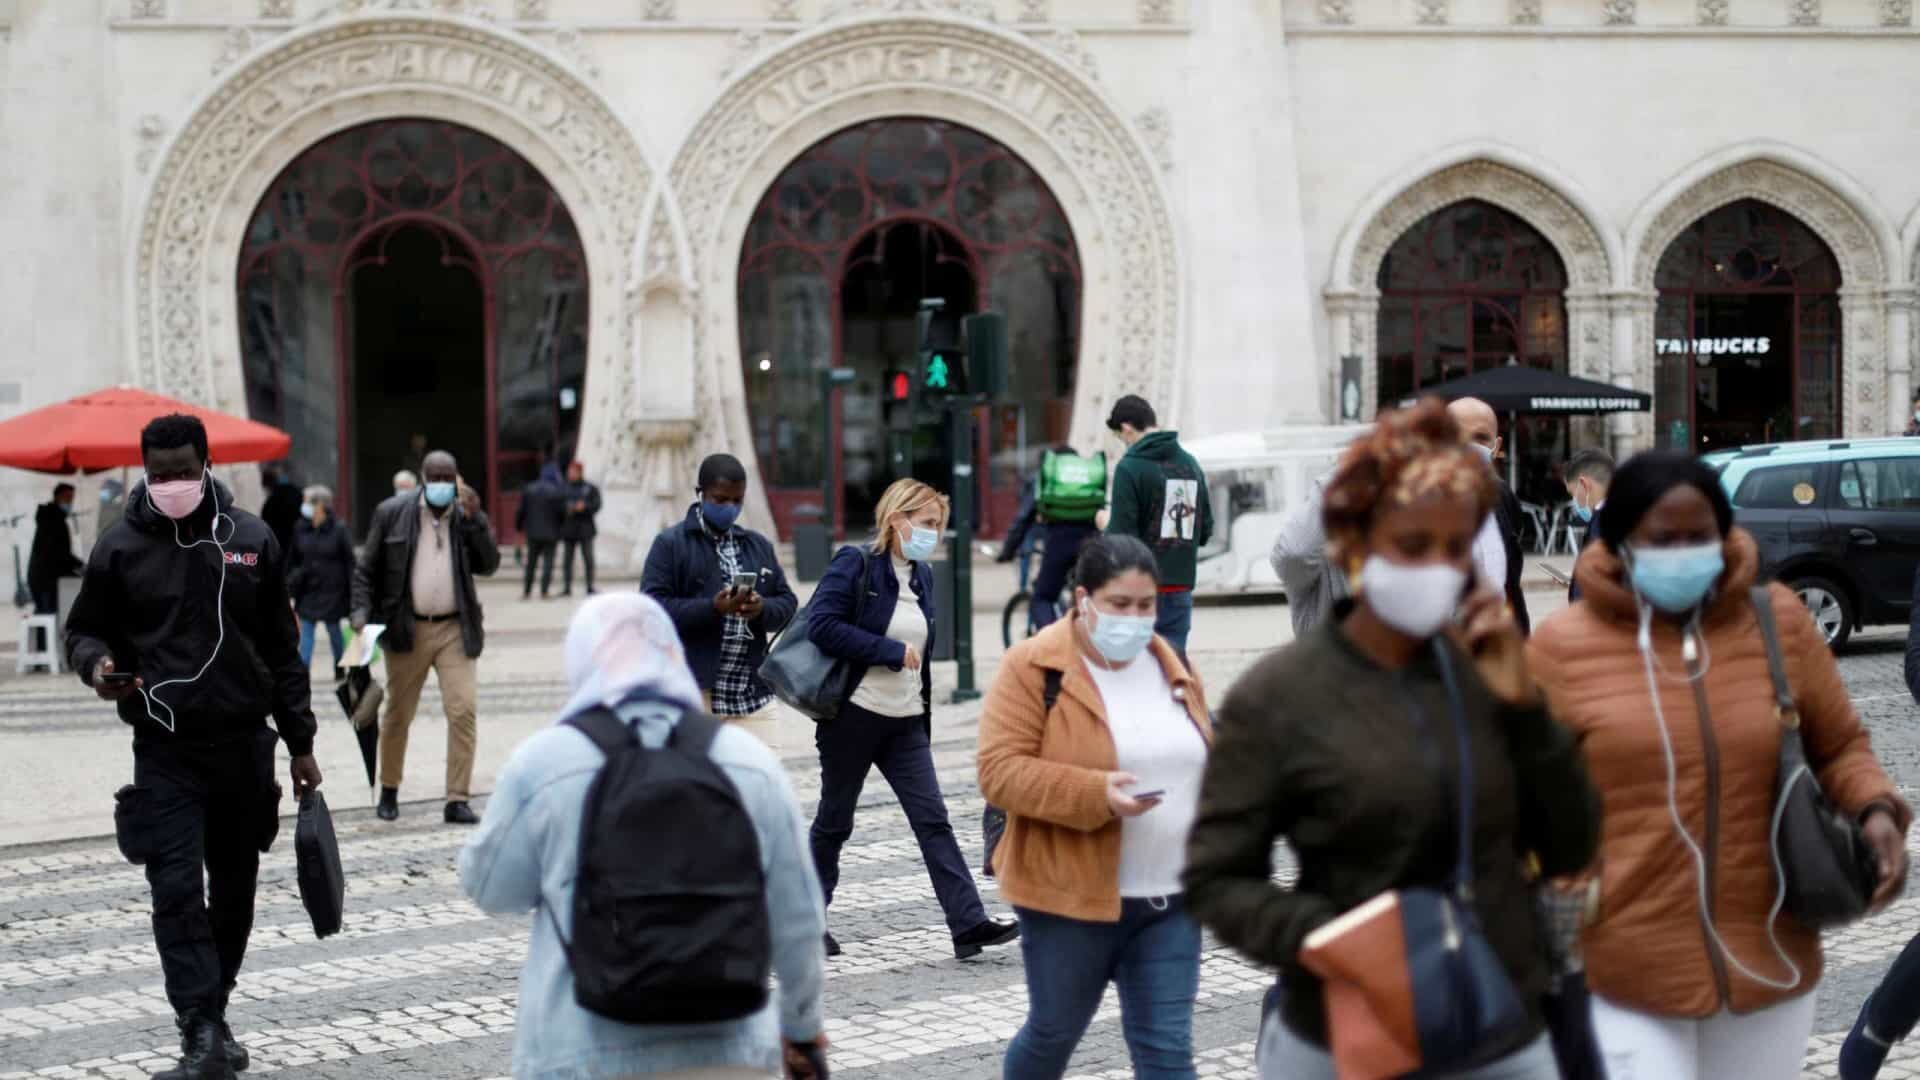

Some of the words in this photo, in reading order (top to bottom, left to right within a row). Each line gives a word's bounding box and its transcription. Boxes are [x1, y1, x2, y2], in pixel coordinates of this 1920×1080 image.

[1655, 337, 1770, 354] TARBUCKS
[1530, 397, 1597, 409] STARBUCKS
[1599, 397, 1640, 409] COFFEE
